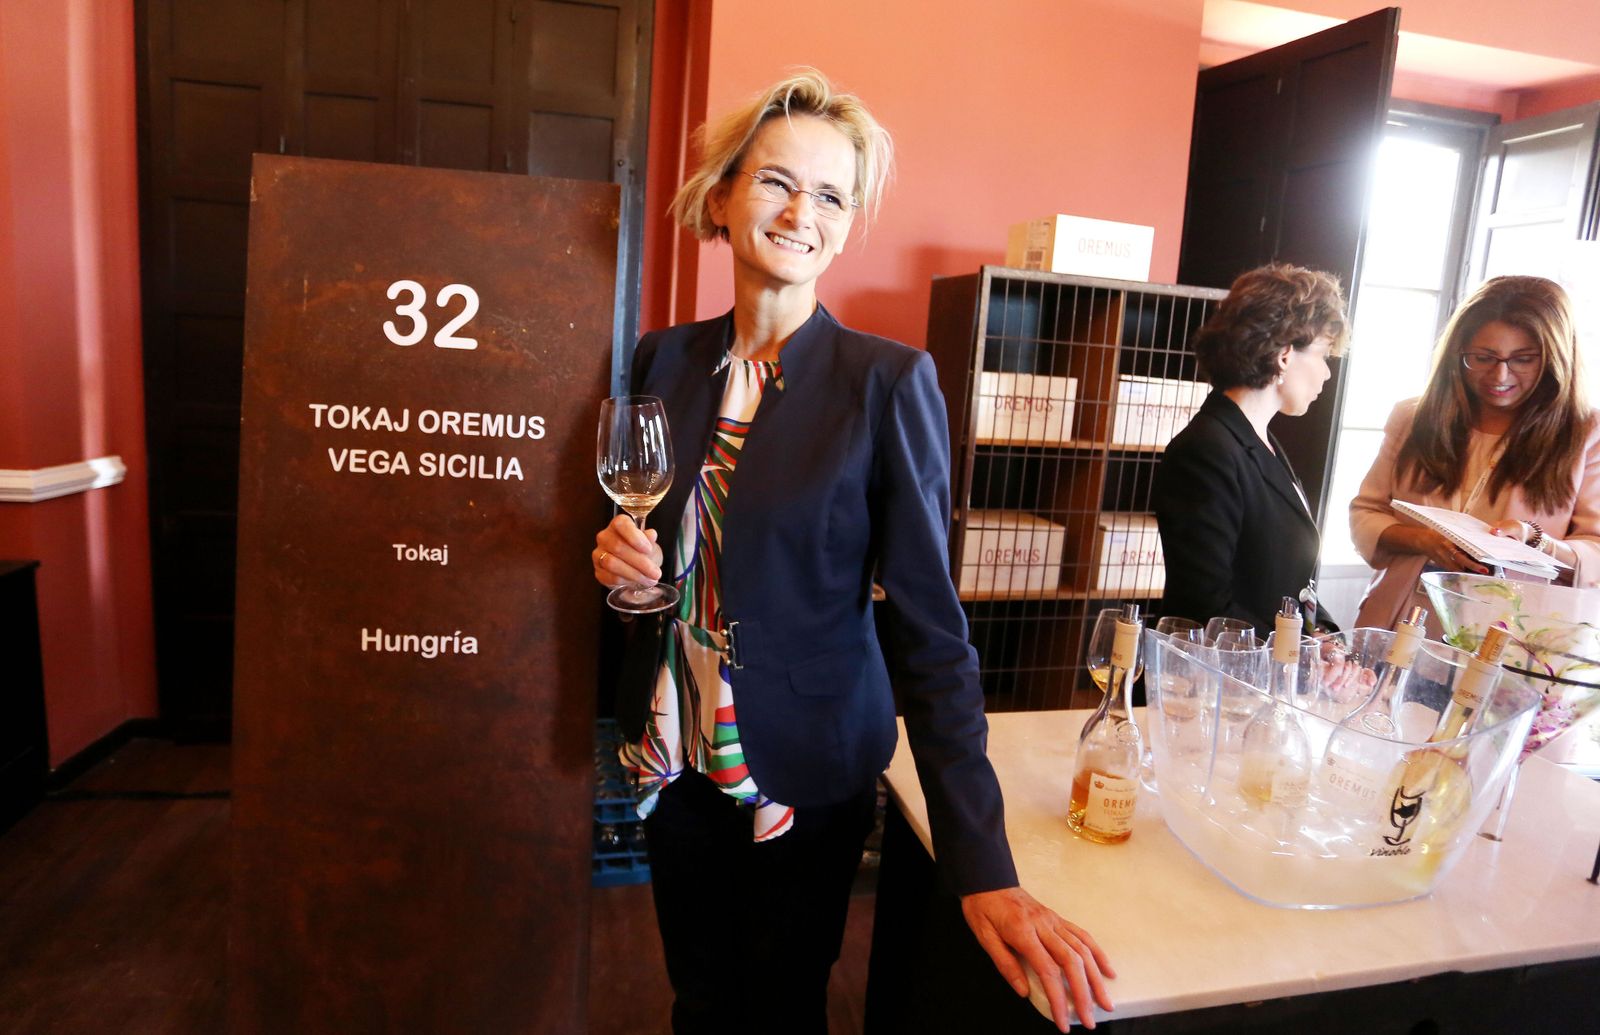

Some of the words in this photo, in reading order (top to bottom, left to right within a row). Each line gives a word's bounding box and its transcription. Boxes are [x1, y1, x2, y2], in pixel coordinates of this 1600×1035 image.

[1077, 237, 1131, 259] OREMUS
[382, 279, 480, 350] 32
[994, 394, 1054, 413] OREMUS
[308, 403, 410, 433] TOKAJ
[417, 409, 546, 440] OREMUS
[327, 447, 411, 475] VEGA
[418, 452, 524, 481] SICILIA
[392, 543, 448, 566] Tokaj
[984, 548, 1041, 564] OREMUS
[1120, 549, 1165, 566] OREMU
[361, 628, 478, 659] Hungría
[1328, 772, 1378, 800] OREMUS
